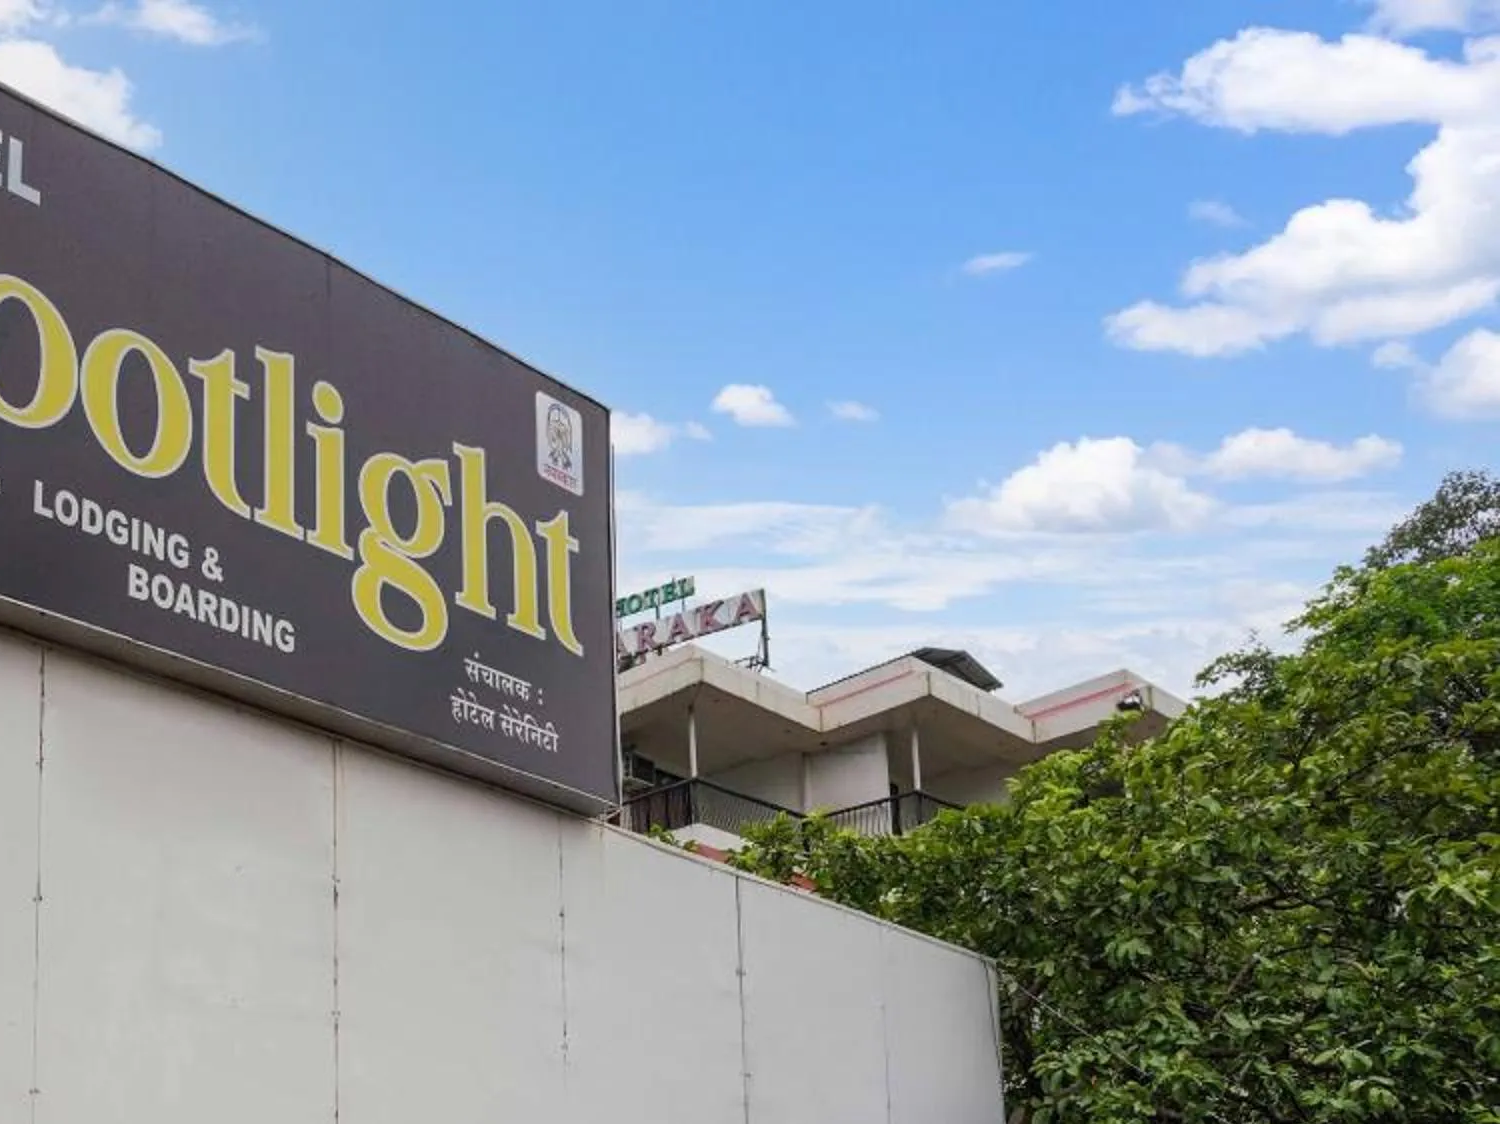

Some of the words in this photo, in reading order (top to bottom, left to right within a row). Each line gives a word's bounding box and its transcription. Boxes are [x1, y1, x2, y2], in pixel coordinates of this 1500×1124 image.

[33, 479, 190, 569] LODGING
[201, 546, 224, 583] &
[127, 563, 296, 653] BOARDING
[450, 687, 495, 731] होटेल
[499, 703, 560, 753] सेरेनिटी
